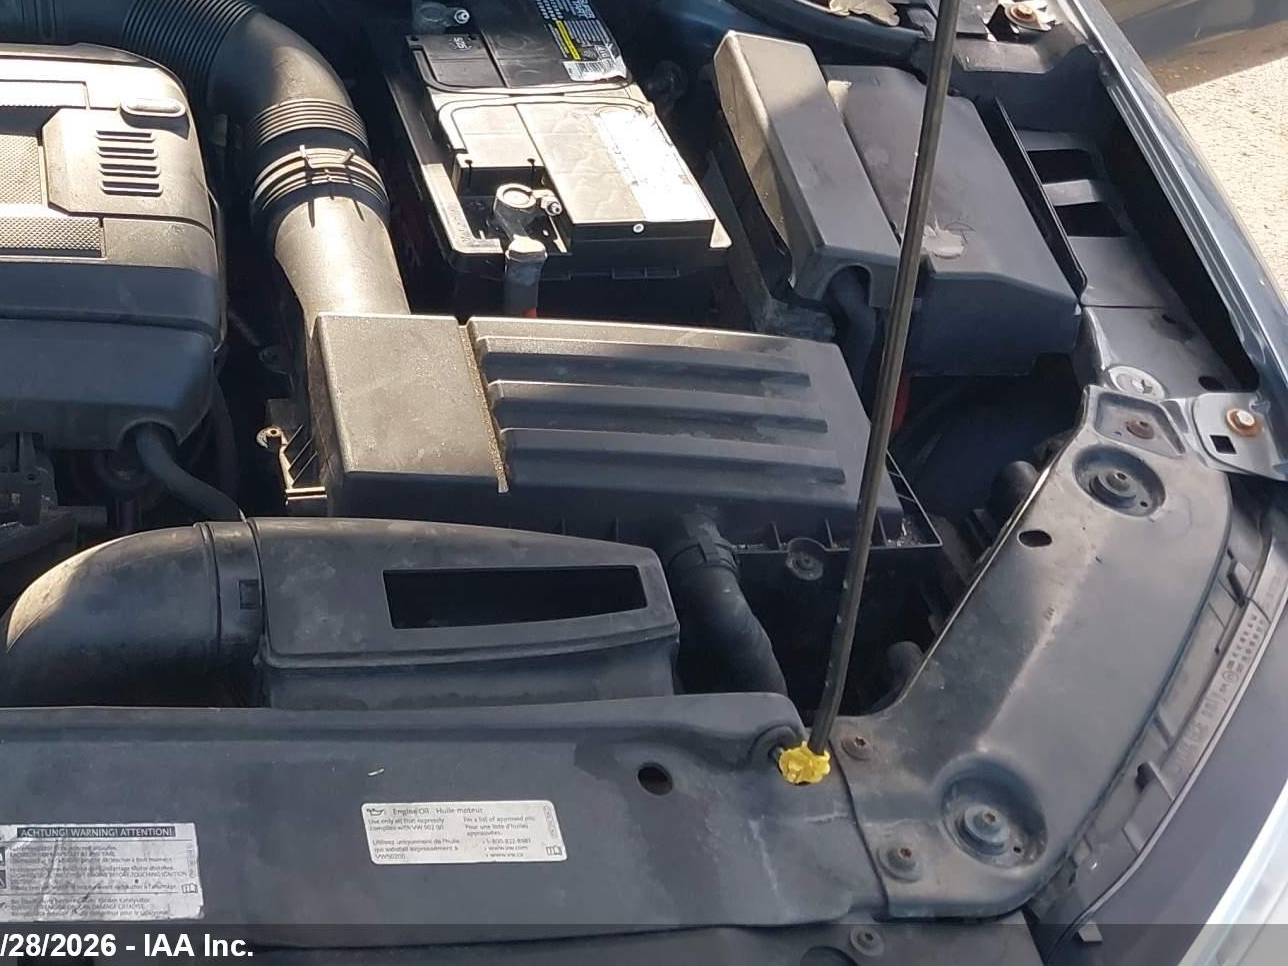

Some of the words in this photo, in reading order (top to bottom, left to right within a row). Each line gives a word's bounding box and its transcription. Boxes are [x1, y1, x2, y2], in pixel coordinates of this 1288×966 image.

[393, 808, 417, 816] Engine
[21, 828, 70, 838] ACHTUNG!
[71, 826, 120, 837] WARNING!
[121, 826, 173, 836] ATTENTION!
